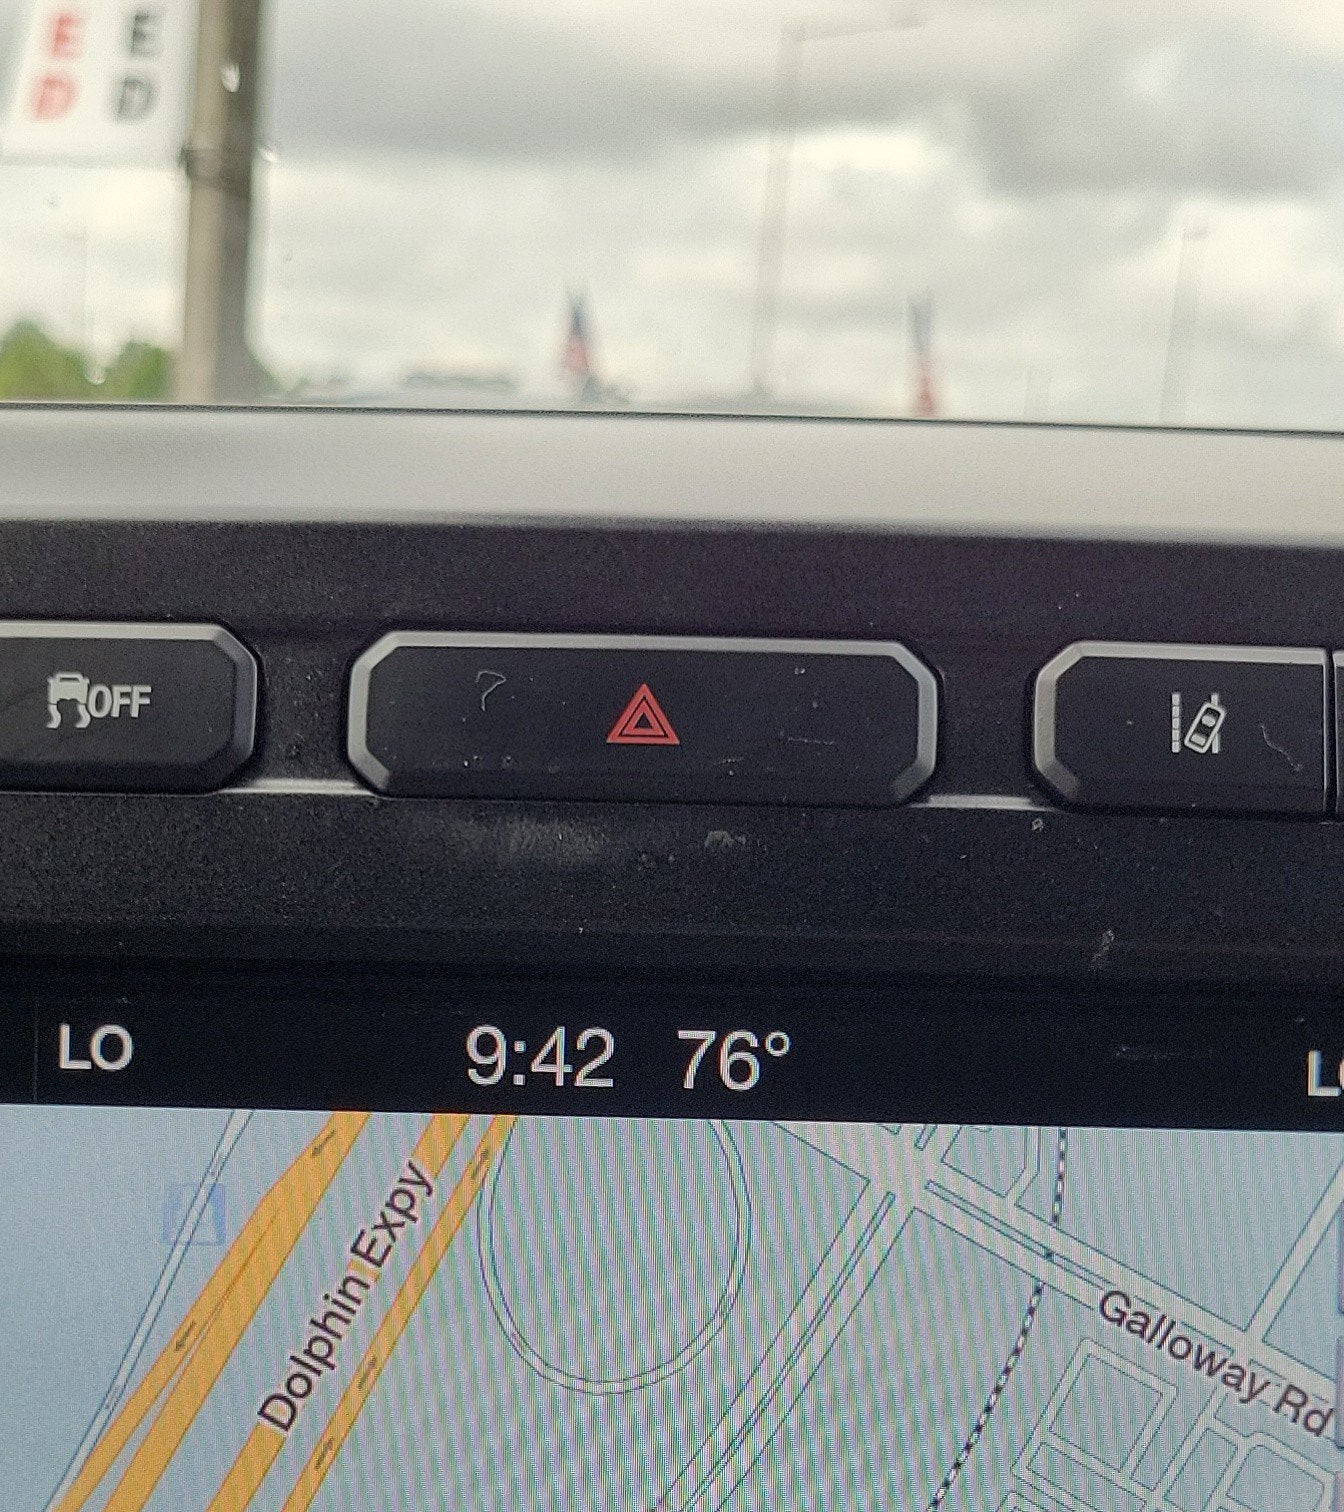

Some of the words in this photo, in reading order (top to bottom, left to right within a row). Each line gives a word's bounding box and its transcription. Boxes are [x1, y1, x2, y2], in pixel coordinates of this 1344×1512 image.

[88, 685, 151, 718] OFF
[58, 1022, 135, 1073] LO
[465, 1024, 615, 1089] 9:42
[676, 1029, 791, 1091] 76°
[256, 1274, 371, 1432] Dolphin
[349, 1160, 434, 1268] Expy
[1097, 1288, 1272, 1405] Galloway
[1271, 1382, 1335, 1437] Rd
